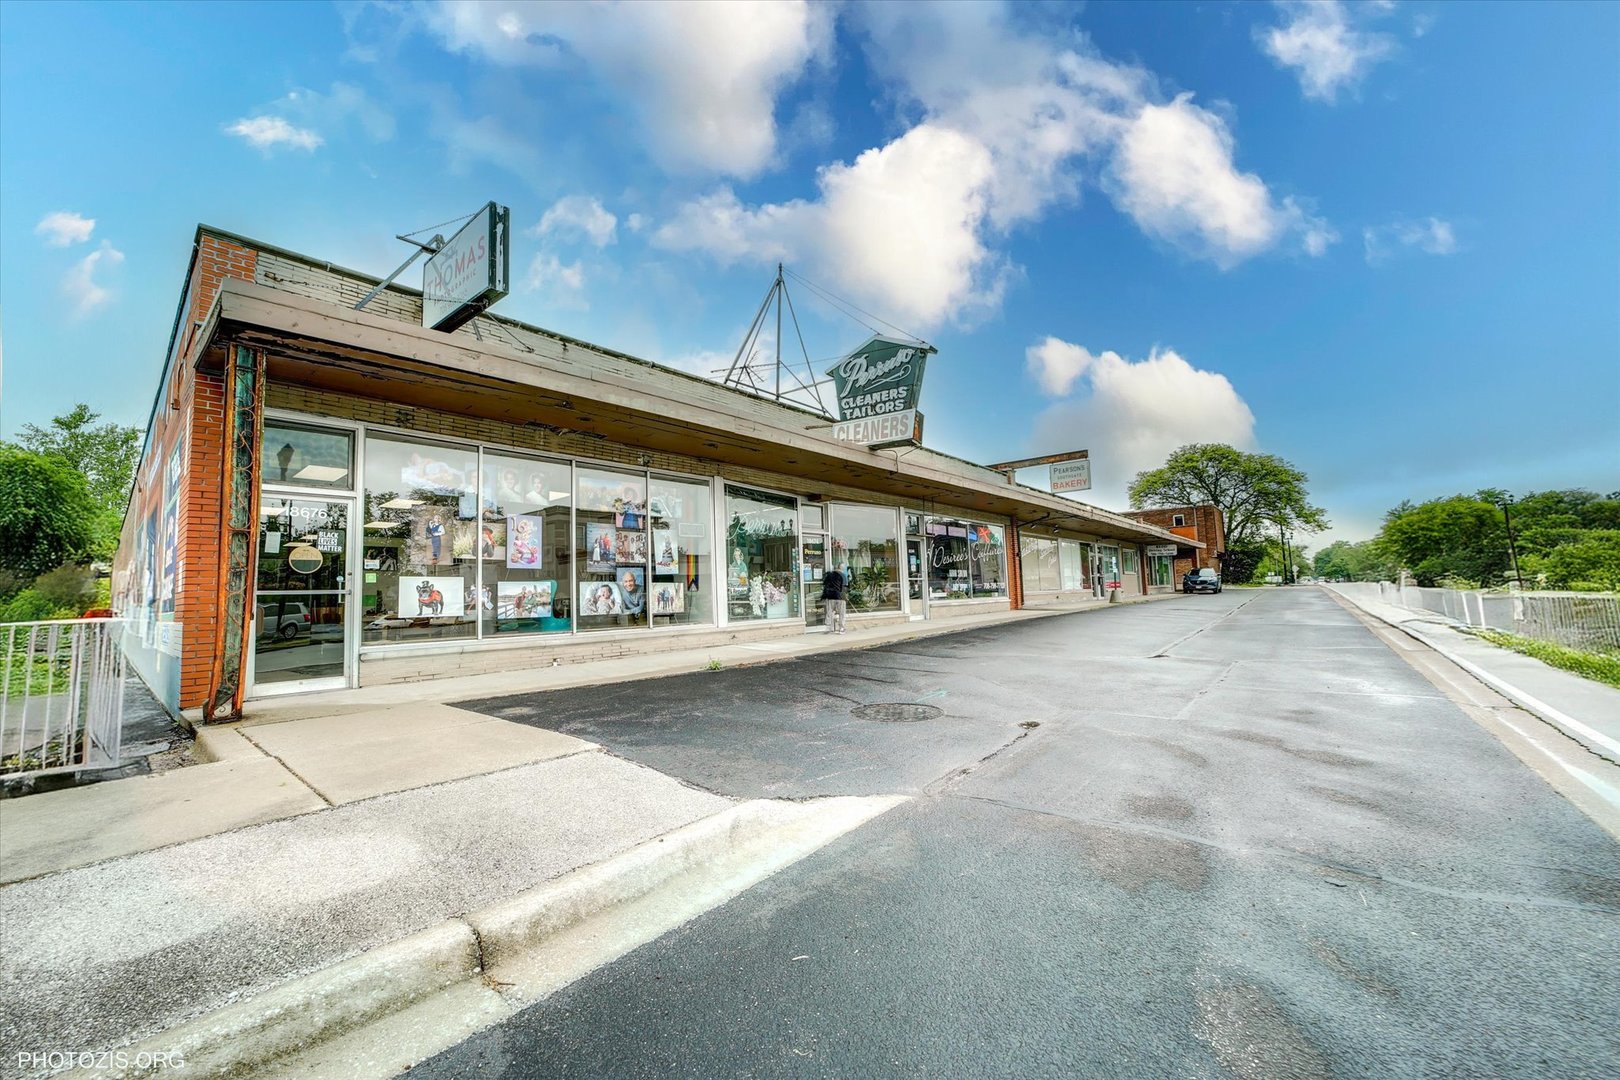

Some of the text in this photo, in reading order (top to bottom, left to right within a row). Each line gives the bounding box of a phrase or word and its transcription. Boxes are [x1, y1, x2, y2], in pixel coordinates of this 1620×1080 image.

[427, 236, 485, 301] THOMAS
[840, 386, 908, 409] CLEANERS
[842, 399, 905, 420] TAILORS
[837, 414, 909, 442] CLEANERS
[1053, 478, 1088, 489] BAKERY
[286, 506, 328, 519] 18676
[317, 538, 338, 546] LIVES
[318, 531, 339, 539] BLACK
